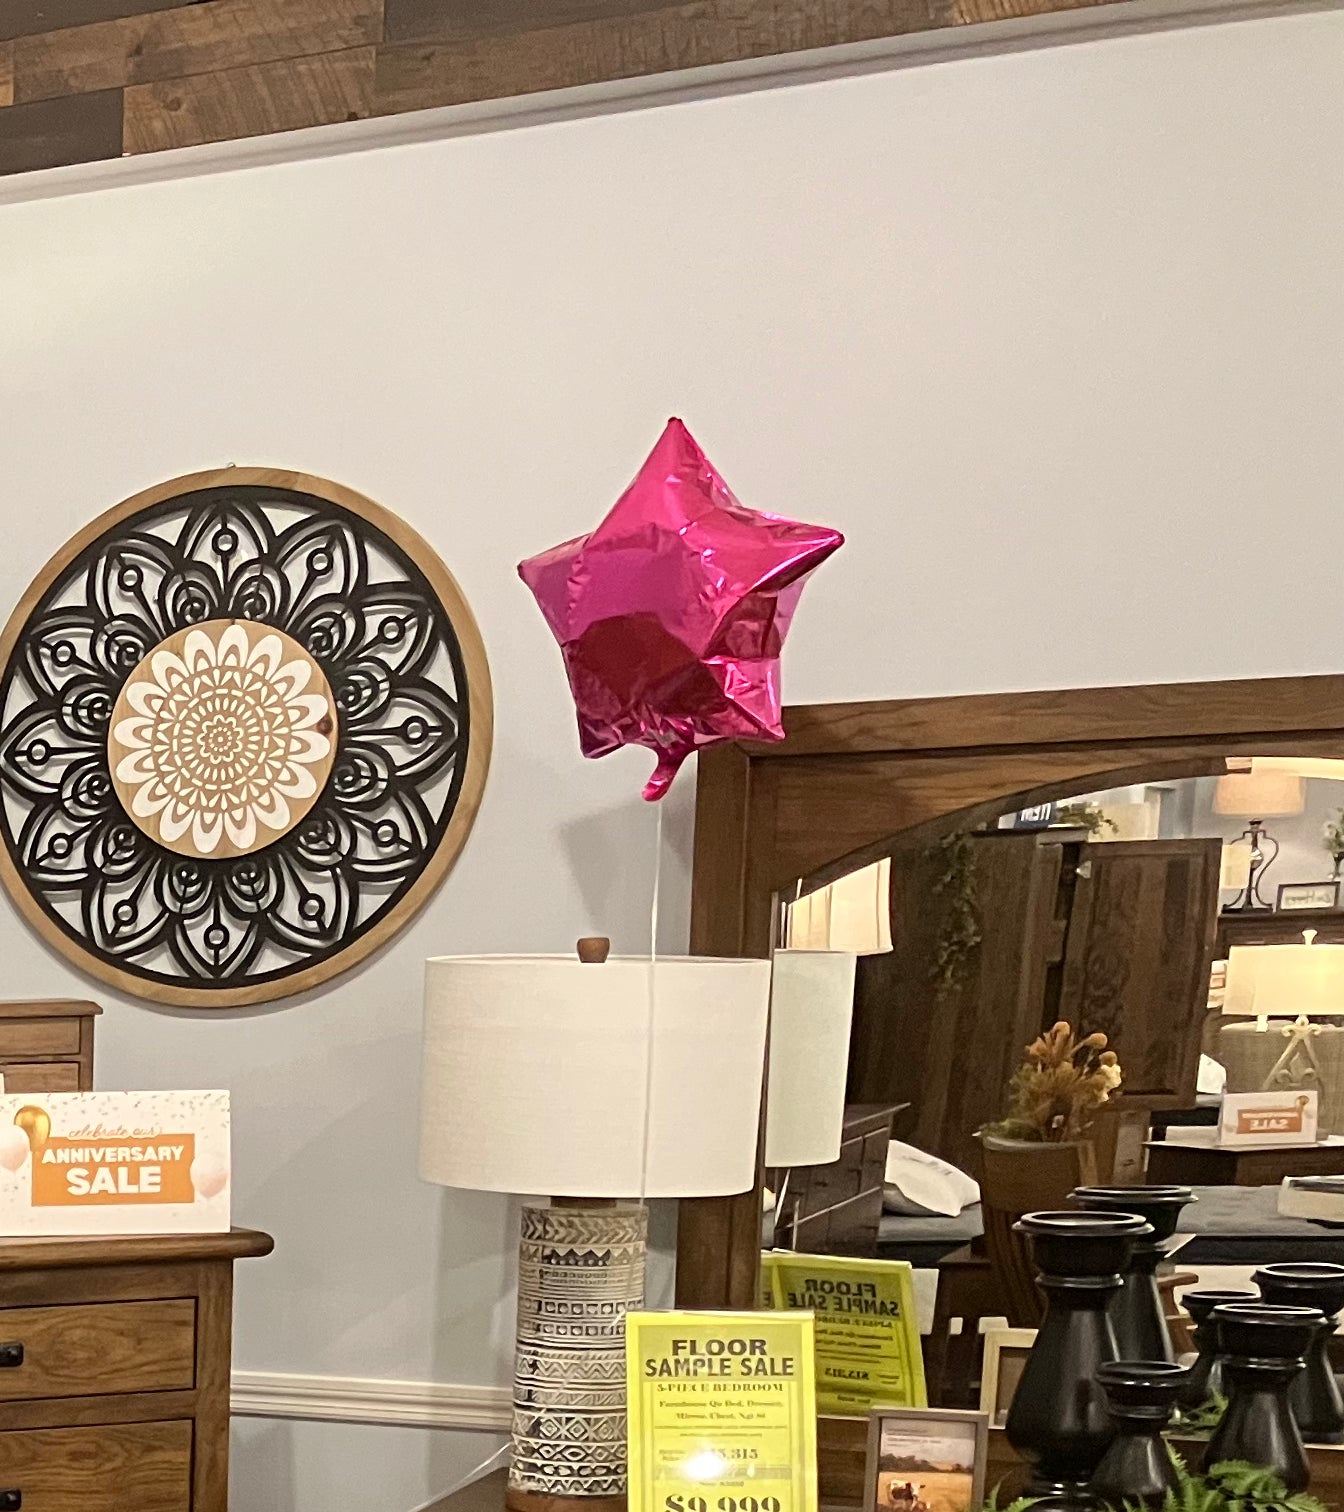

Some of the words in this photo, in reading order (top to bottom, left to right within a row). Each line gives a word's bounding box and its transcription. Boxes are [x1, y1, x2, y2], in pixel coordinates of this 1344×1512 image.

[68, 1124, 129, 1139] celebrate
[41, 1145, 185, 1164] ANNIVERSARY
[66, 1166, 161, 1196] SALE
[671, 1339, 768, 1356] FLOOR
[645, 1357, 732, 1377] SAMPLE
[740, 1357, 794, 1377] SALE
[713, 1383, 783, 1392] BEDROOM
